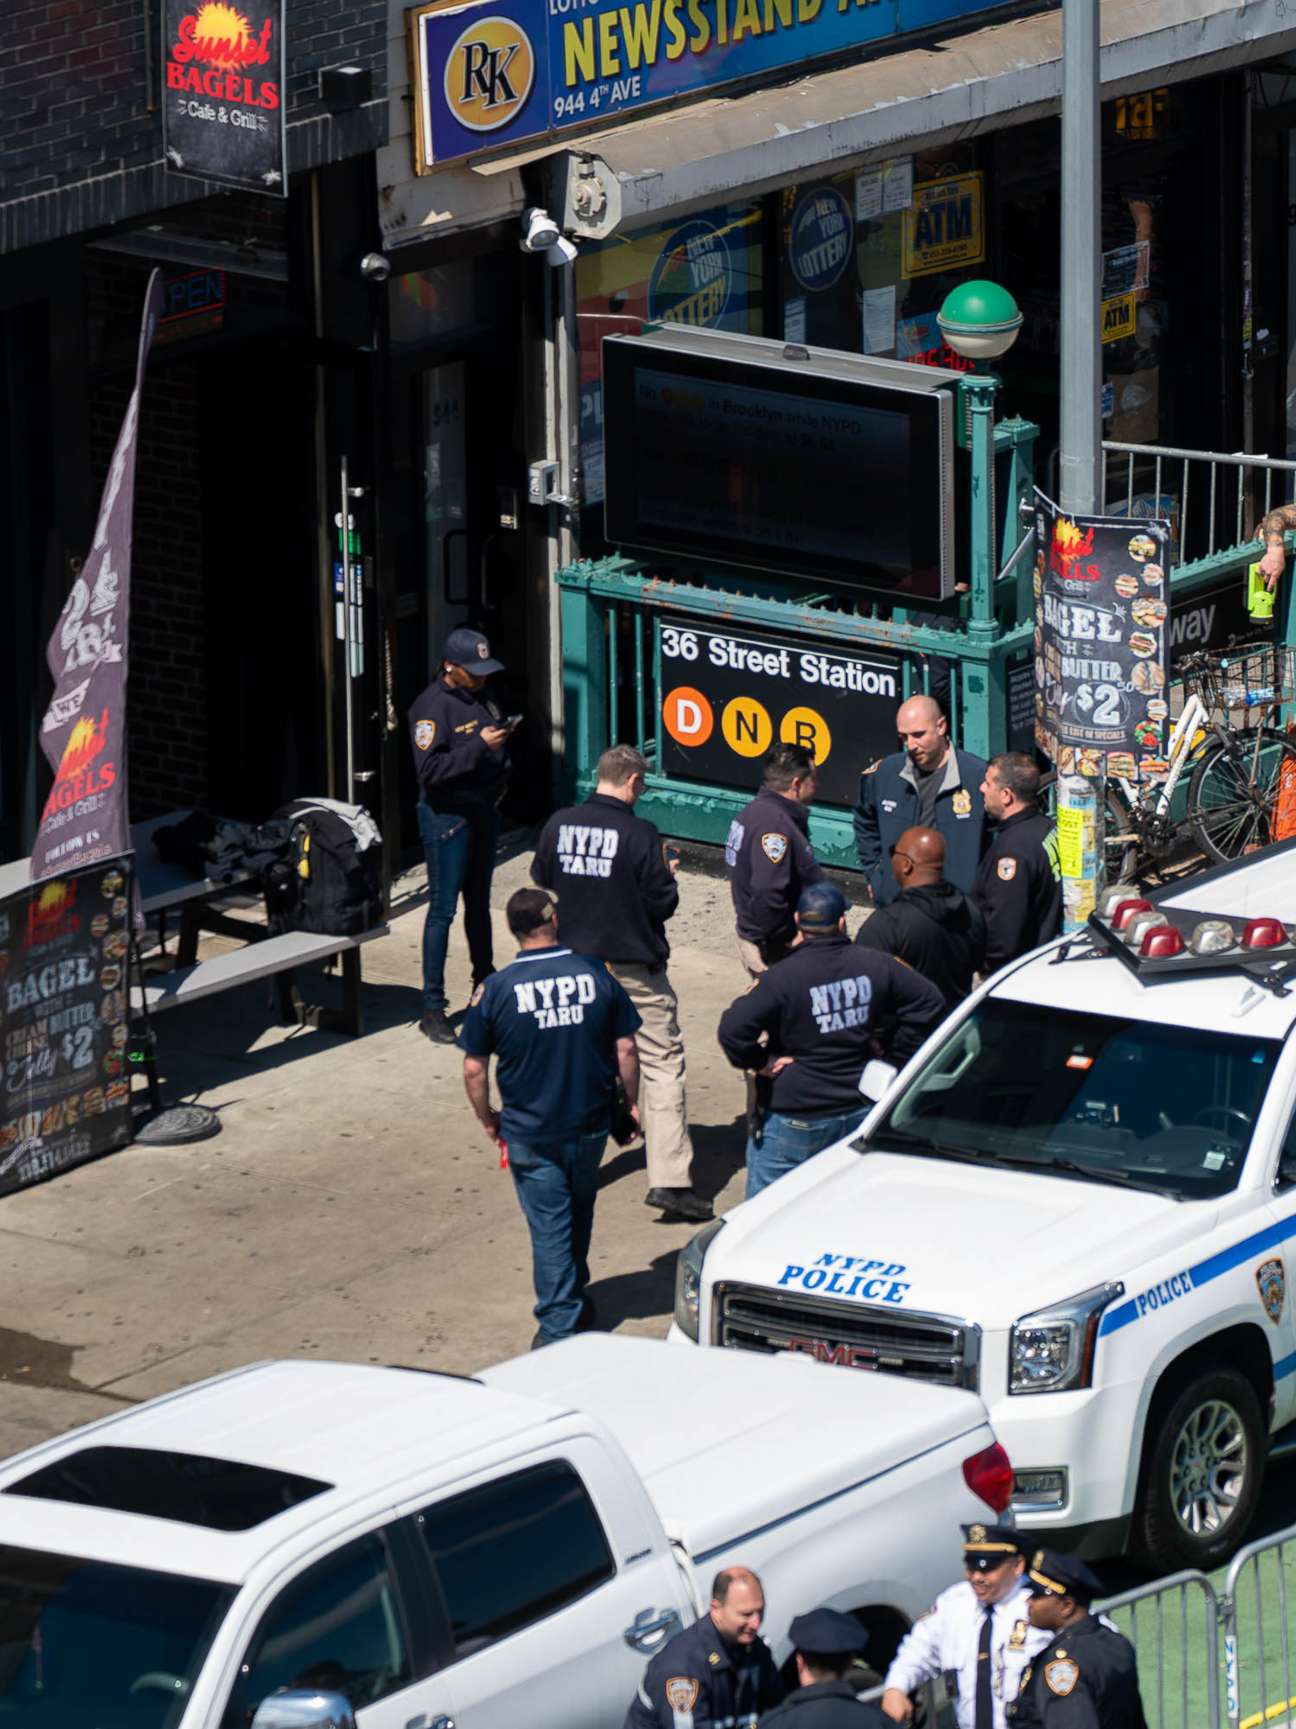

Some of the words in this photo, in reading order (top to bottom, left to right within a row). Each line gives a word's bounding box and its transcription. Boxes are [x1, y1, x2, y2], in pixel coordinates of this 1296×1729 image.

[166, 62, 280, 110] BAGELS
[459, 41, 520, 110] RK
[187, 101, 215, 121] Cafe
[217, 106, 229, 124] &
[230, 109, 257, 130] Grill
[554, 92, 585, 119] 944
[610, 75, 641, 103] AVE
[815, 199, 838, 217] NEW
[817, 211, 845, 239] YORK
[914, 196, 972, 252] ATM
[798, 230, 847, 278] LOTTERY
[166, 272, 224, 313] PEN
[1103, 302, 1130, 331] ATM
[821, 415, 863, 435] NYPD
[661, 628, 699, 661] 36
[708, 637, 791, 678] Street
[800, 654, 896, 697] Station
[1062, 658, 1122, 682] BUTTER
[676, 698, 702, 735] D
[736, 710, 758, 744] N
[795, 720, 816, 755] R
[42, 762, 116, 823] AGELS
[557, 825, 619, 859] NYPD
[559, 854, 612, 878] TARU
[6, 956, 95, 1014] BAGEL
[514, 973, 596, 1013] NYPD
[809, 974, 872, 1016] NYPD
[534, 1004, 584, 1029] TARU
[816, 1005, 869, 1034] TARU
[63, 1026, 93, 1070] $2
[813, 1252, 906, 1277] NYPD
[779, 1264, 911, 1304] POLICE
[1137, 1270, 1192, 1317] POLICE
